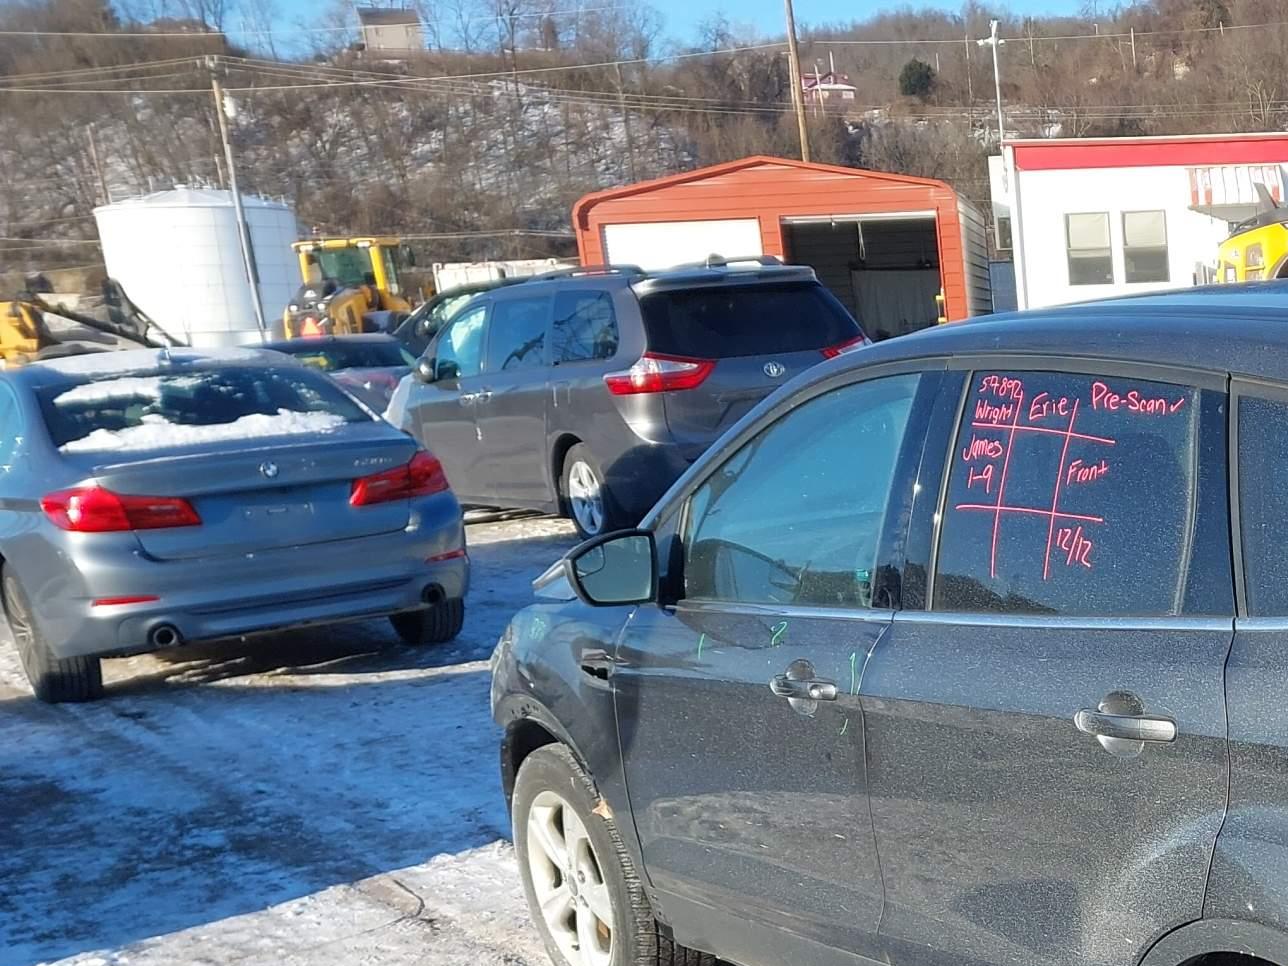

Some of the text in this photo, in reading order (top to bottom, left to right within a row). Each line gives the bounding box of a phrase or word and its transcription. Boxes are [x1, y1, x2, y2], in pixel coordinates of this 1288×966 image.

[1029, 392, 1068, 420] Erie
[1092, 381, 1166, 415] Pre-Scan
[963, 433, 1003, 461] James
[967, 464, 993, 494] 1-9
[1066, 459, 1108, 485] Front
[1056, 526, 1092, 567] 12/12
